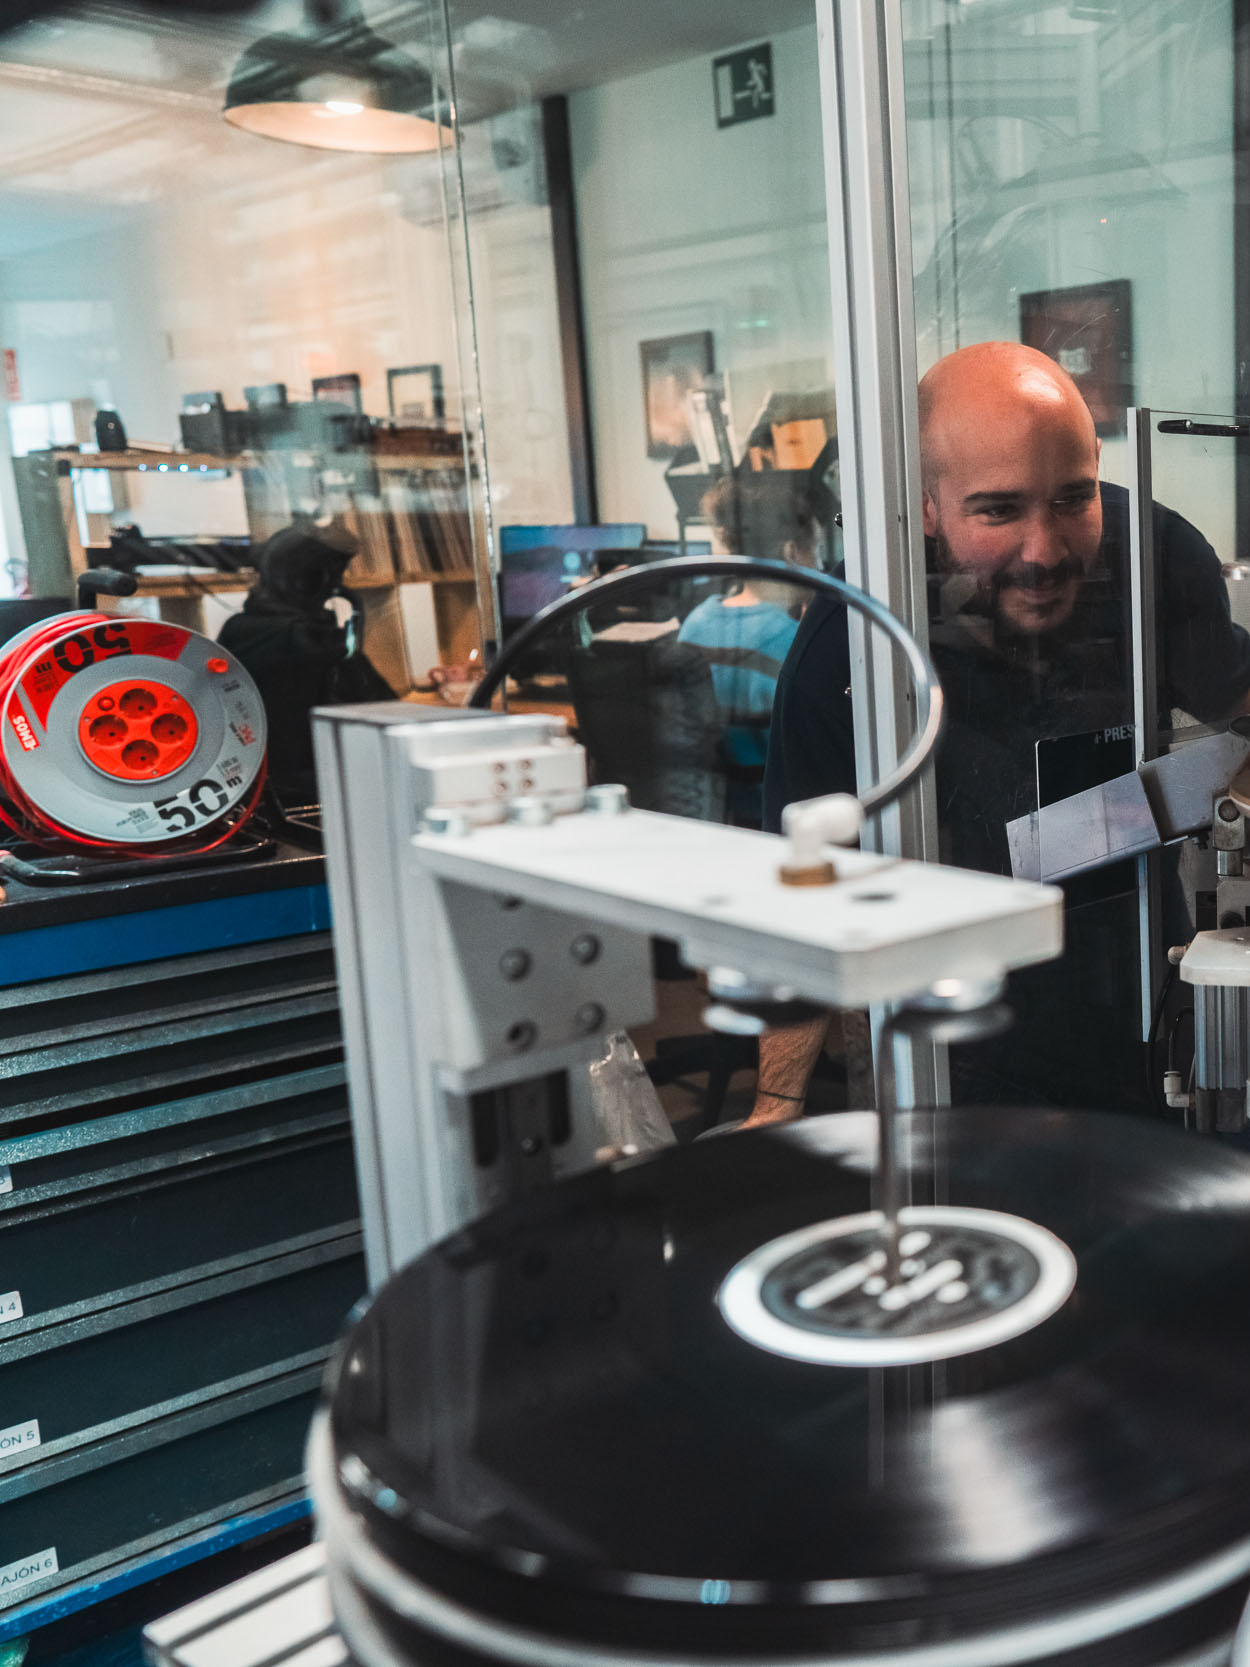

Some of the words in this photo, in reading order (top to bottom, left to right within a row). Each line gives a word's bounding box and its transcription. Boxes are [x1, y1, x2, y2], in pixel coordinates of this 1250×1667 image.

[53, 623, 132, 673] 50
[153, 779, 229, 832] 50
[26, 1430, 35, 1441] 5
[44, 1558, 53, 1569] 6
